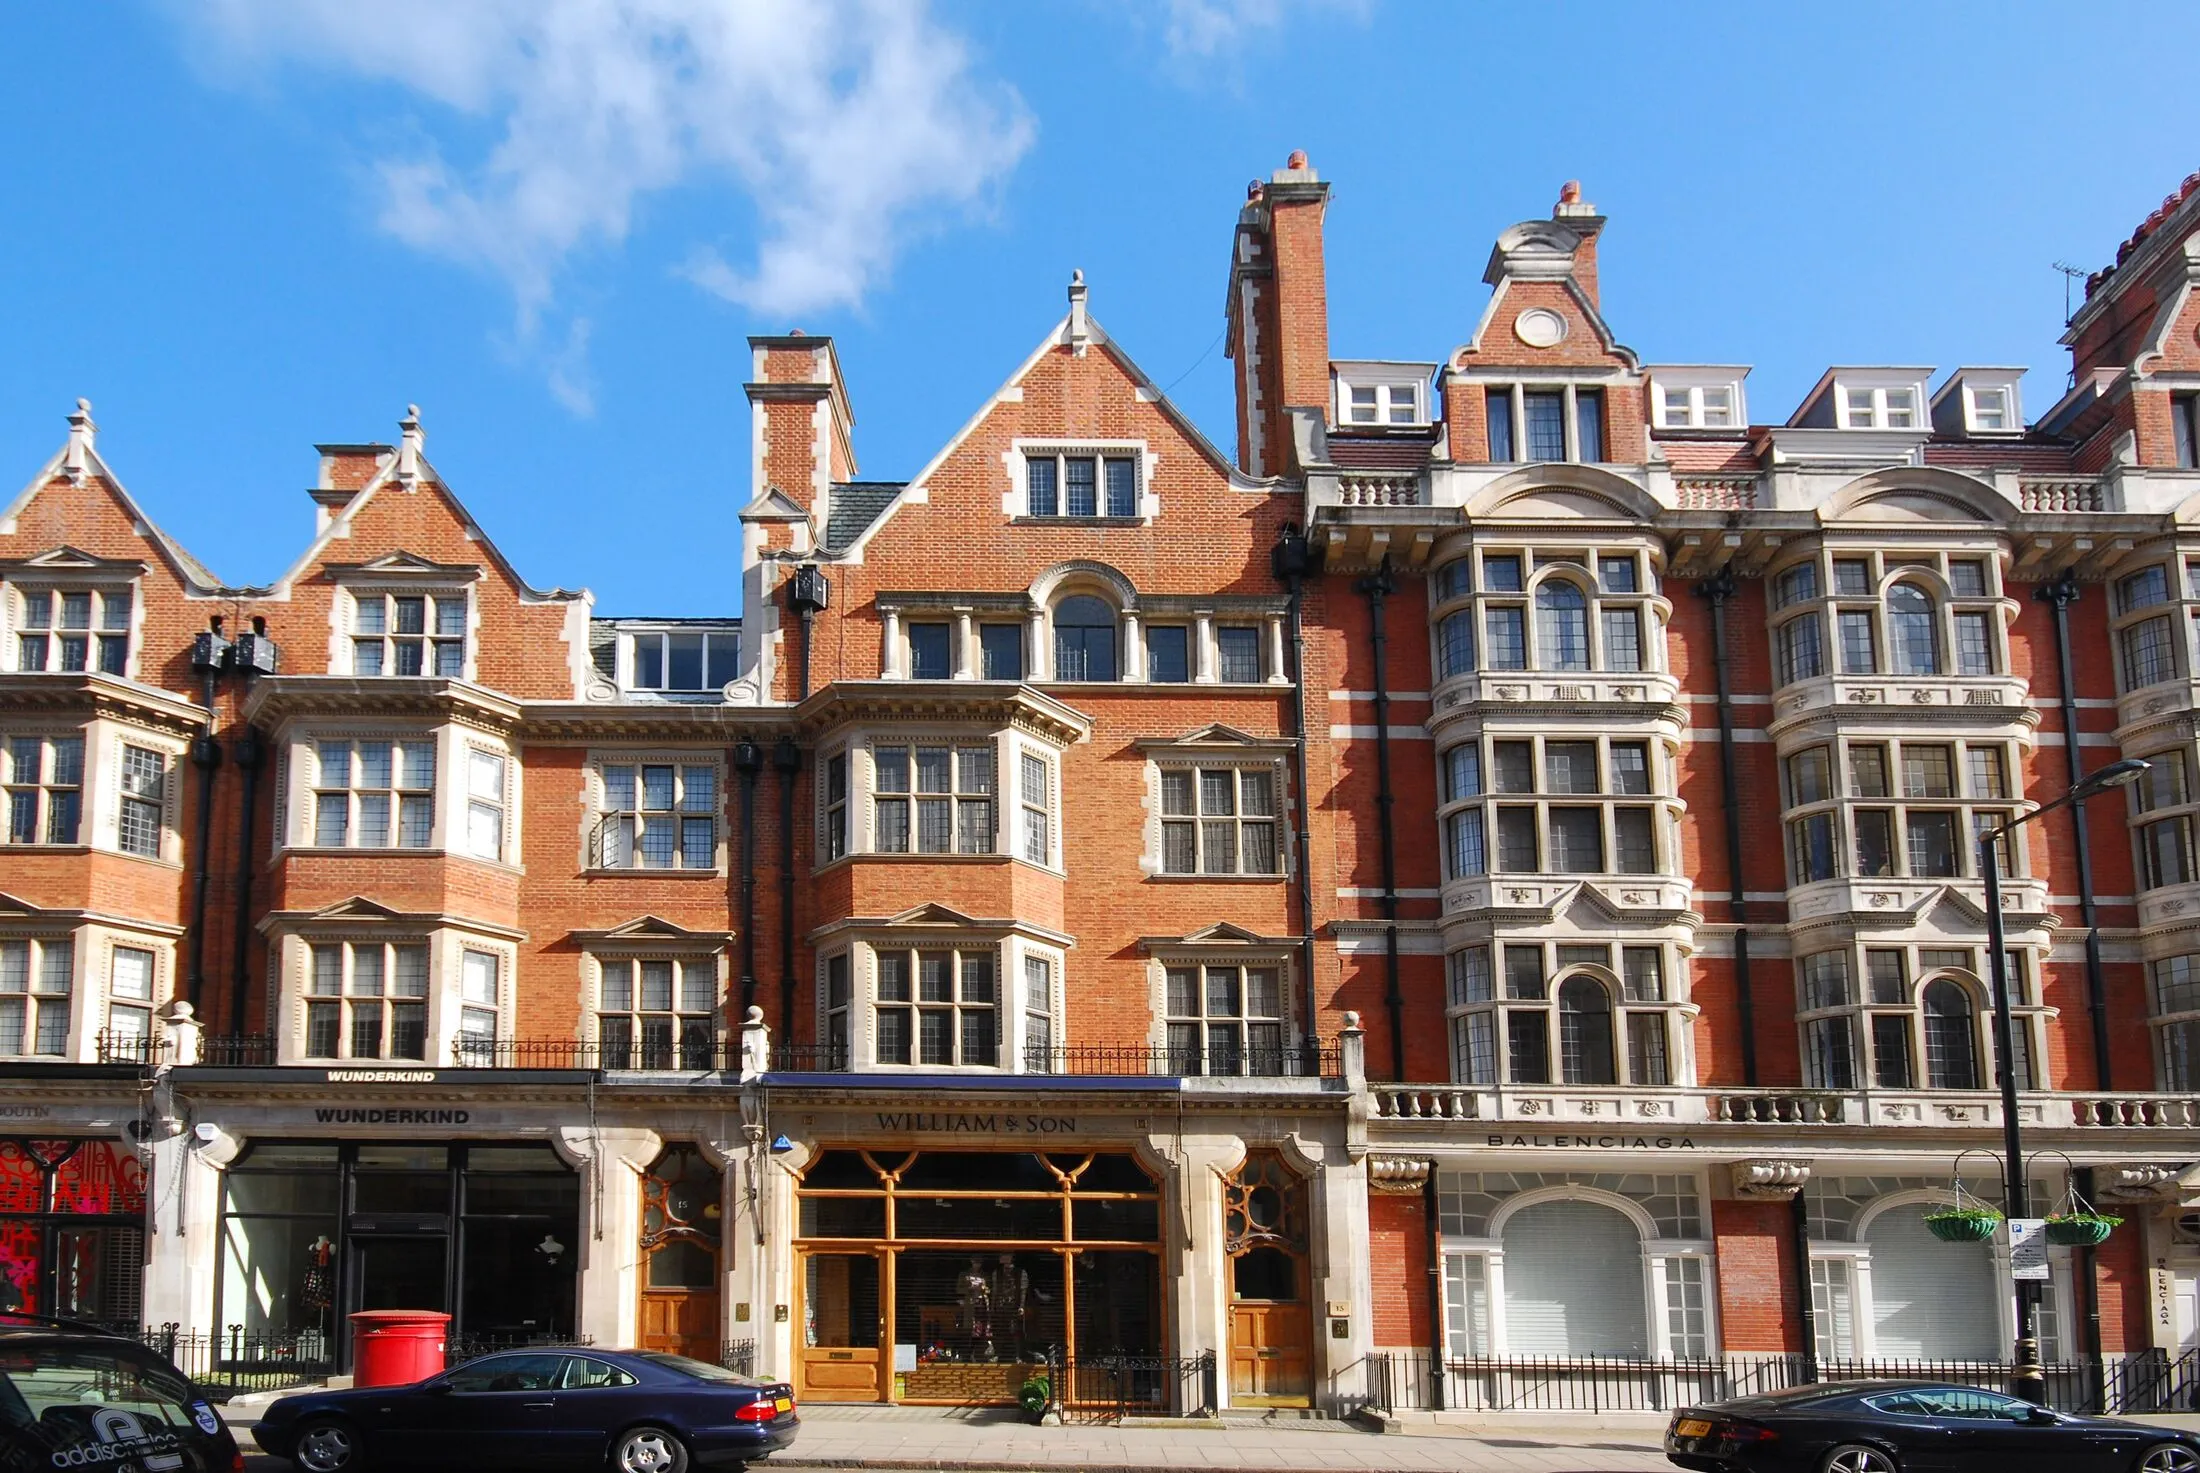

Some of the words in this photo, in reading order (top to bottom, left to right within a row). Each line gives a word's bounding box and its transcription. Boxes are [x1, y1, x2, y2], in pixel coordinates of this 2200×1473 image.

[327, 1071, 436, 1082] WUNDERKIND
[315, 1108, 470, 1124] WUNDERKIND
[876, 1113, 997, 1132] WILLIAM
[1005, 1115, 1019, 1132] &
[1026, 1115, 1077, 1133] SON
[1487, 1135, 1696, 1149] BALENCIAGA
[2157, 1258, 2169, 1325] BALENCIAGA
